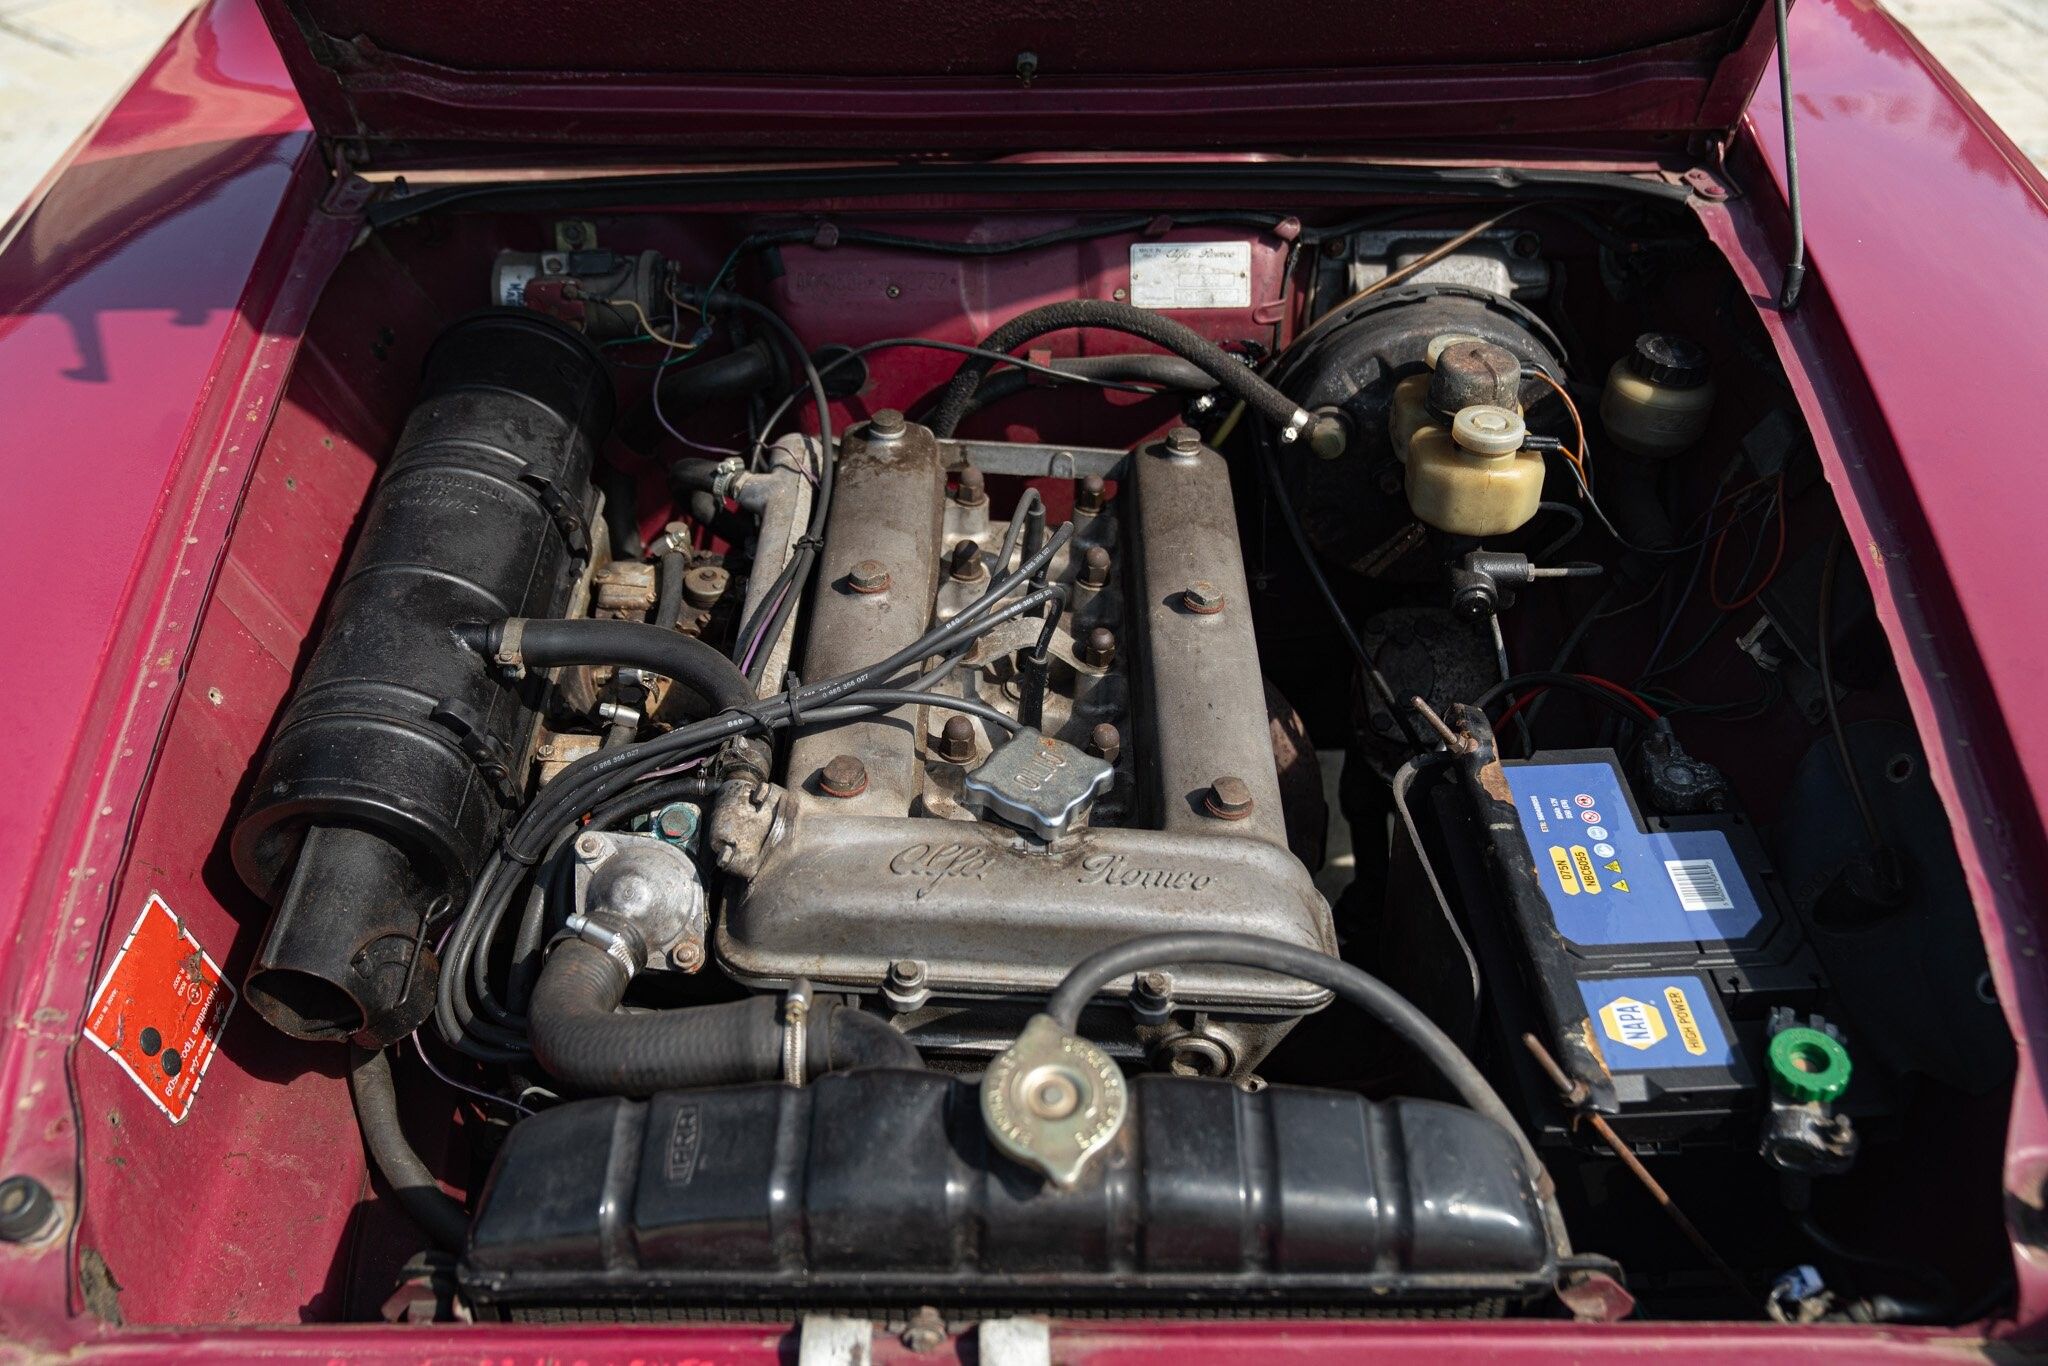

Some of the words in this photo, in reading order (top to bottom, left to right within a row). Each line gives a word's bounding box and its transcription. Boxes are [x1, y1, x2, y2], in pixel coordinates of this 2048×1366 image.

[1014, 751, 1067, 791] OLIO
[889, 842, 996, 901] Alfa
[1078, 853, 1218, 892] Romeo
[1575, 851, 1596, 887] NBC6055
[1616, 1005, 1650, 1040] NAPA
[1668, 992, 1691, 1024] POWER
[1684, 1026, 1700, 1048] HIGH
